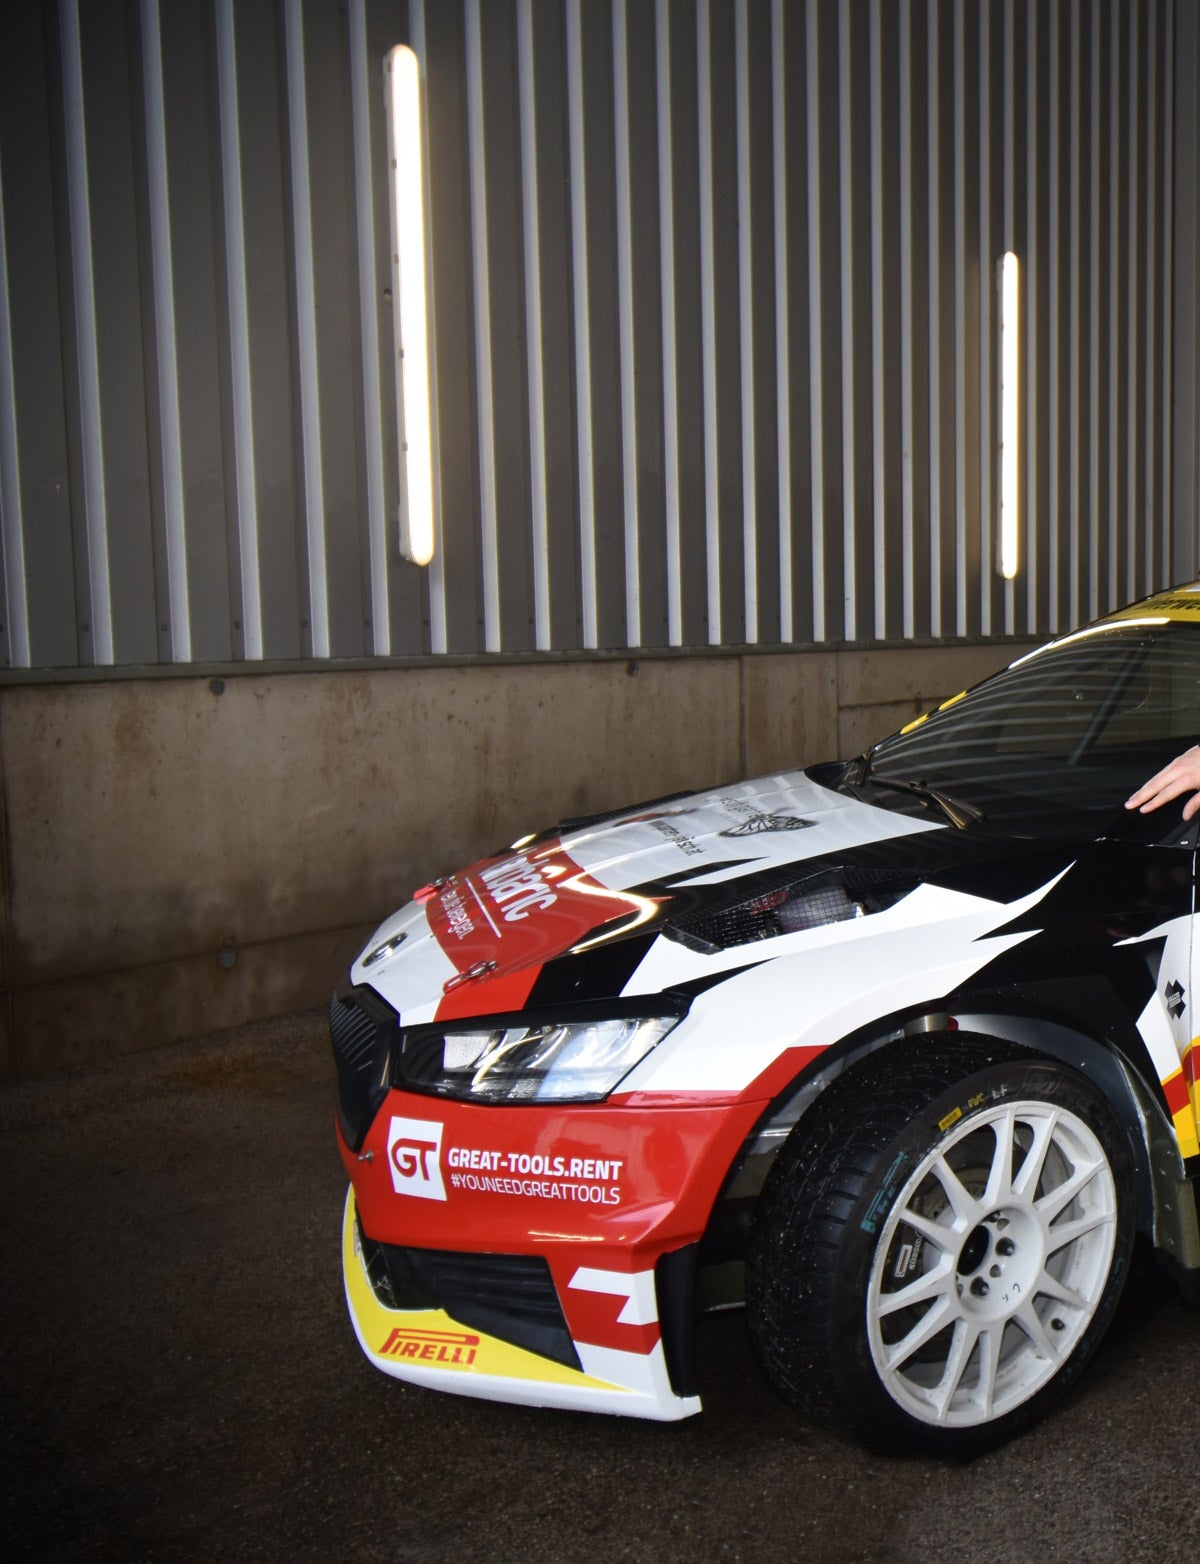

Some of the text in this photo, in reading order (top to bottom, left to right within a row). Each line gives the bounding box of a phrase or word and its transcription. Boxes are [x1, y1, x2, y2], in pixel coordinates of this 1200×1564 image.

[391, 1138, 437, 1181] GT
[448, 1148, 622, 1180] GREAT-TOOLS.RENT
[450, 1173, 621, 1205] #YOUNEEDGREATTOOLS
[379, 1328, 480, 1365] PIRELLI
